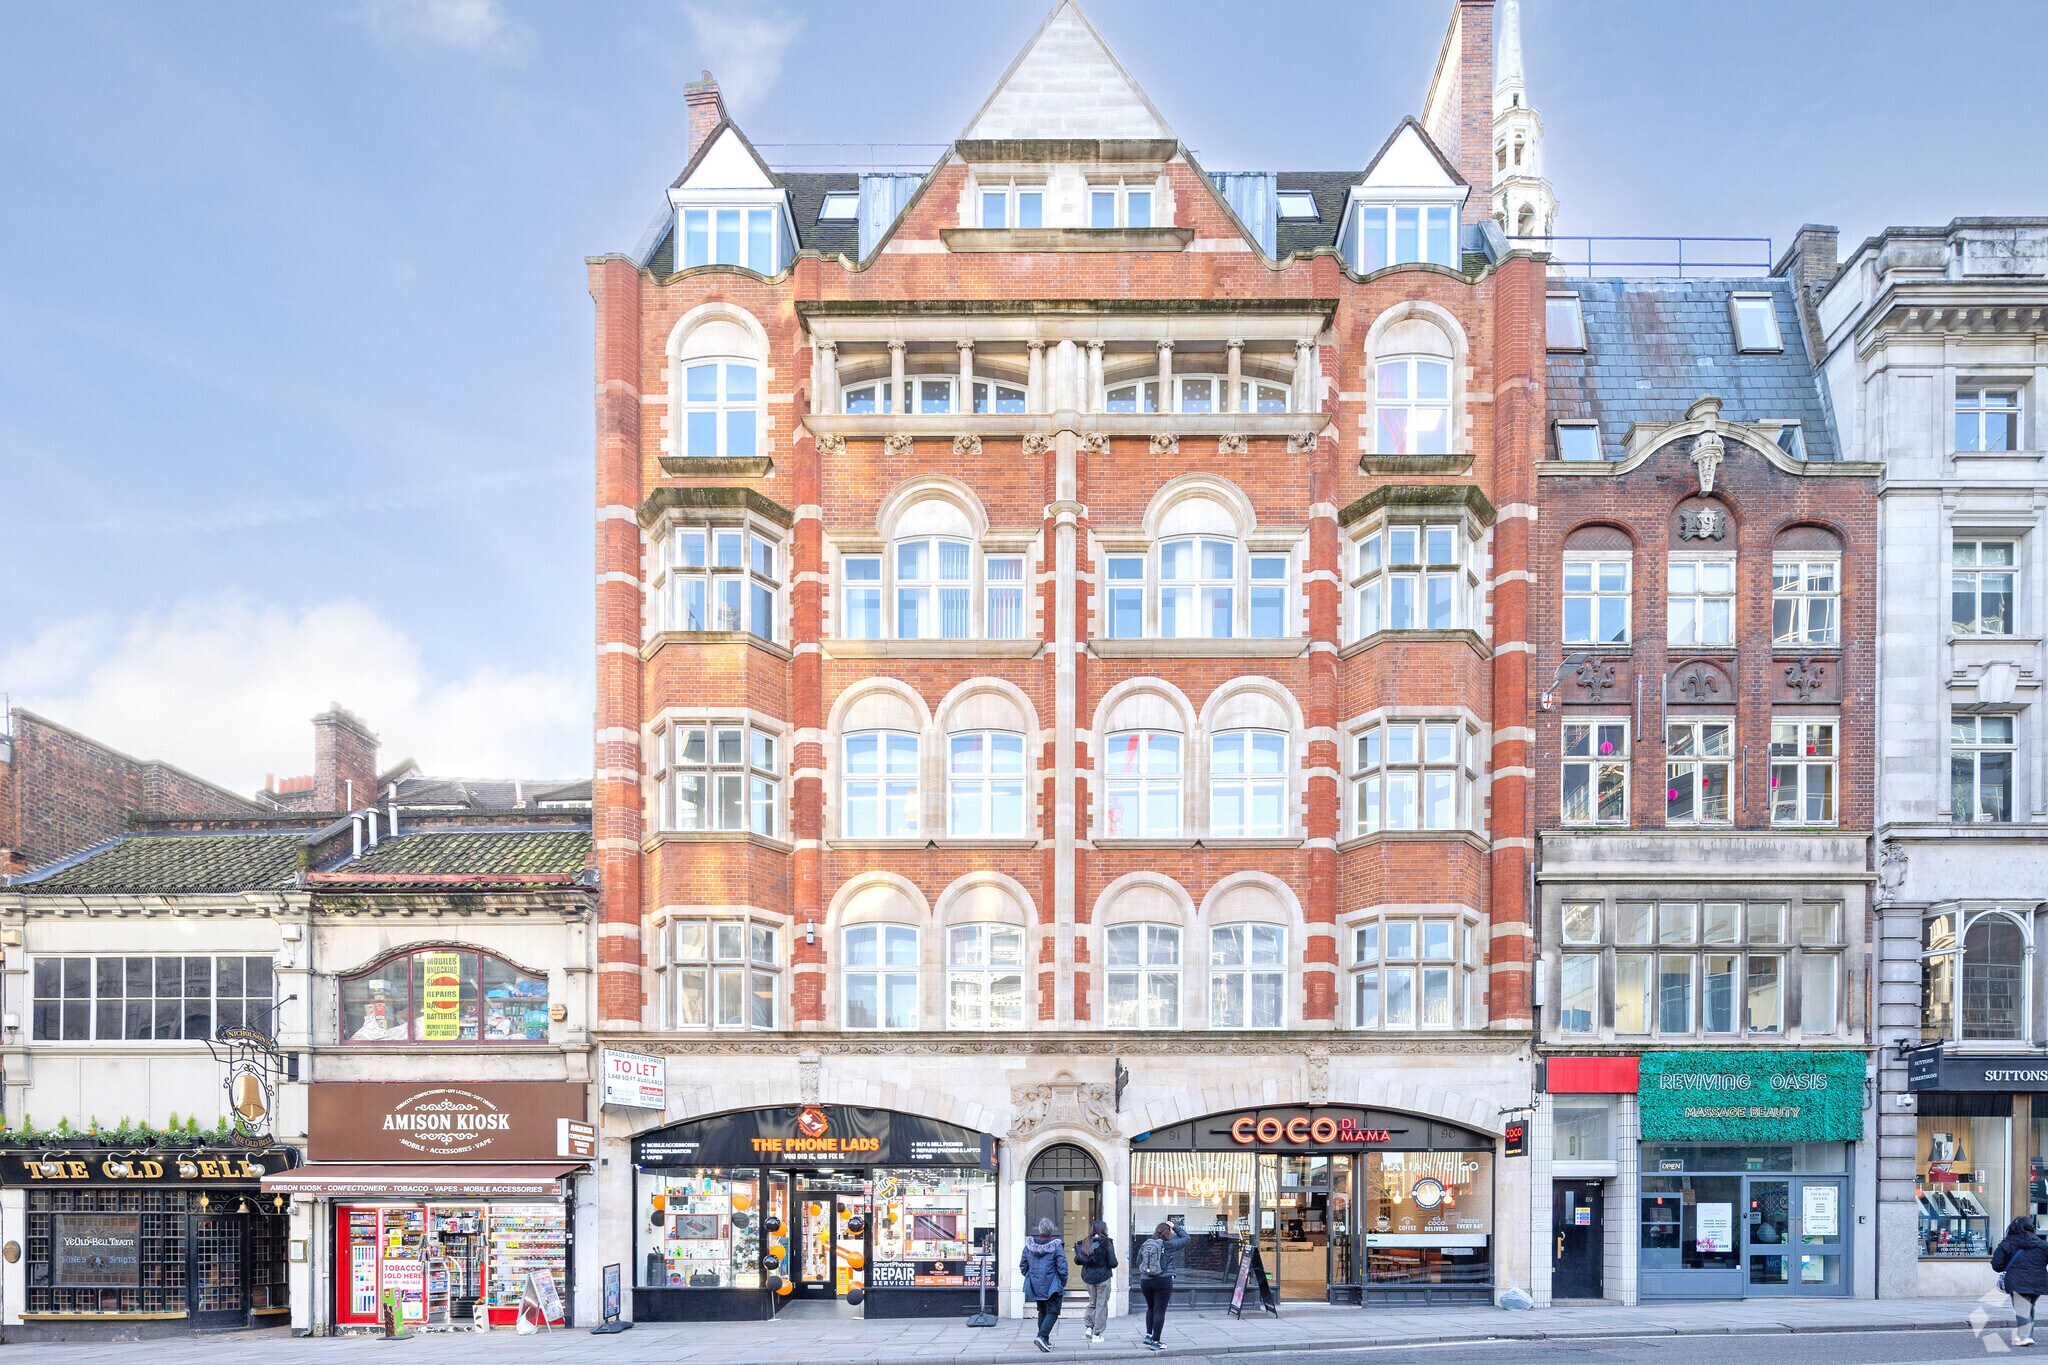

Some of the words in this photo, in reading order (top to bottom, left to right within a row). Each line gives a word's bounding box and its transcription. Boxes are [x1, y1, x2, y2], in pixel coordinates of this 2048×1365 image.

[427, 966, 458, 974] UNLOCKING
[608, 1051, 626, 1059] GRADE
[631, 1055, 648, 1063] OFFICE
[1914, 1058, 1934, 1066] SUTTONS
[614, 1059, 632, 1073] TO
[636, 1063, 657, 1077] LET
[1659, 1073, 1751, 1090] REVIVING
[1770, 1073, 1828, 1090] OASIS
[1984, 1070, 2048, 1081] SUTTONS
[1684, 1107, 1746, 1118] MASSAGE
[1750, 1107, 1801, 1118] BEAUTY
[382, 1114, 451, 1130] AMISON
[456, 1113, 510, 1130] KIOSK
[1231, 1116, 1338, 1144] COCO
[1341, 1118, 1357, 1129] DI
[1340, 1129, 1391, 1141] MAMA
[1440, 1128, 1456, 1138] 90
[1505, 1127, 1523, 1139] COCO
[233, 1131, 245, 1144] THE
[245, 1138, 259, 1147] OLD
[259, 1136, 271, 1147] BELL
[750, 1138, 783, 1152] THE
[785, 1138, 837, 1152] PHONE
[840, 1138, 880, 1152] LADS
[401, 1139, 425, 1152] MOBILE
[430, 1146, 472, 1154] ACCESSORIES
[475, 1139, 493, 1149] VAPE
[23, 1161, 90, 1179] THE
[102, 1161, 163, 1179] OLD
[1380, 1162, 1431, 1171] ITALIAN
[1437, 1162, 1454, 1171] TO
[1459, 1161, 1479, 1171] GO
[95, 1256, 102, 1264] &
[873, 1268, 915, 1280] REPAIR
